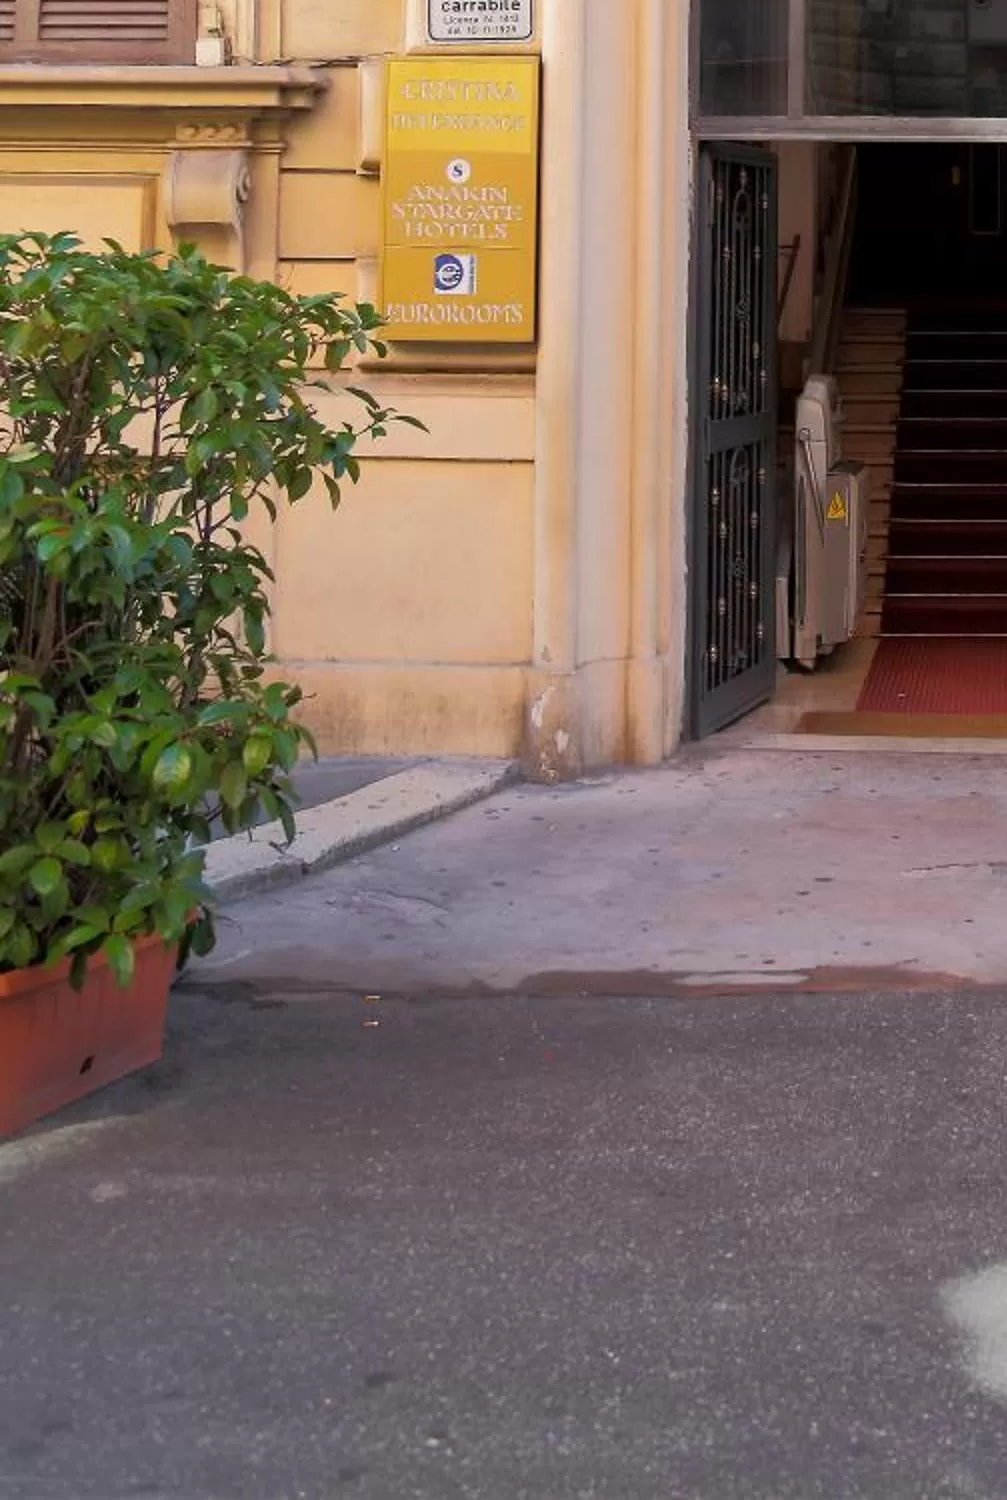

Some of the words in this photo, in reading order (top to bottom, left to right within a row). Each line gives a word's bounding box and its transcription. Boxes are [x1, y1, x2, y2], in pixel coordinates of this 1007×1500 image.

[408, 185, 508, 201] ANAKIN
[392, 203, 523, 221] STARGATE
[405, 223, 508, 240] HOTELS
[386, 303, 523, 325] EUROROOMS
